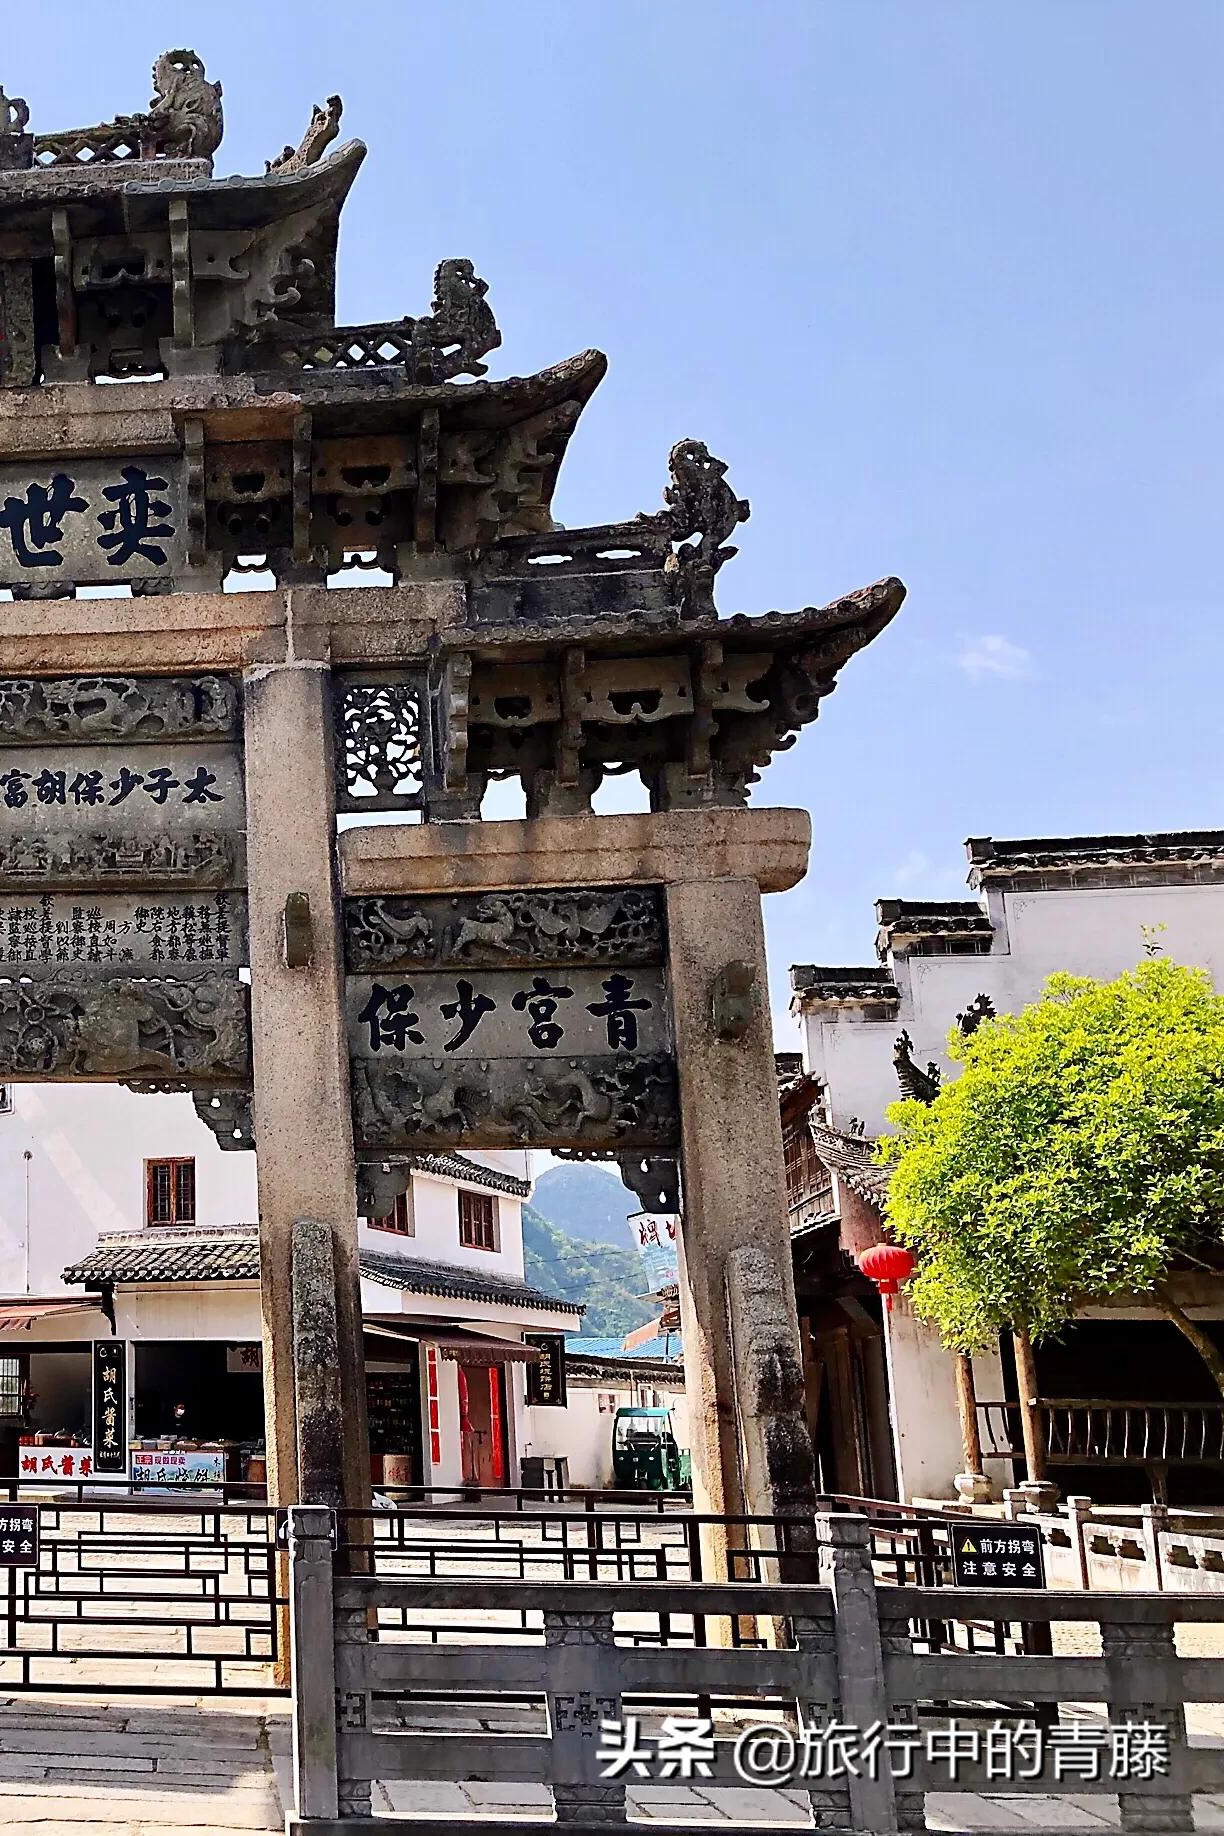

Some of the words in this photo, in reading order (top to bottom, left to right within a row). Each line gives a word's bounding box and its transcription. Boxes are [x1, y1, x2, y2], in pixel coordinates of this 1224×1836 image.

[979, 1538, 1035, 1554] 前方拐弯
[963, 1560, 1036, 1577] 注意安全
